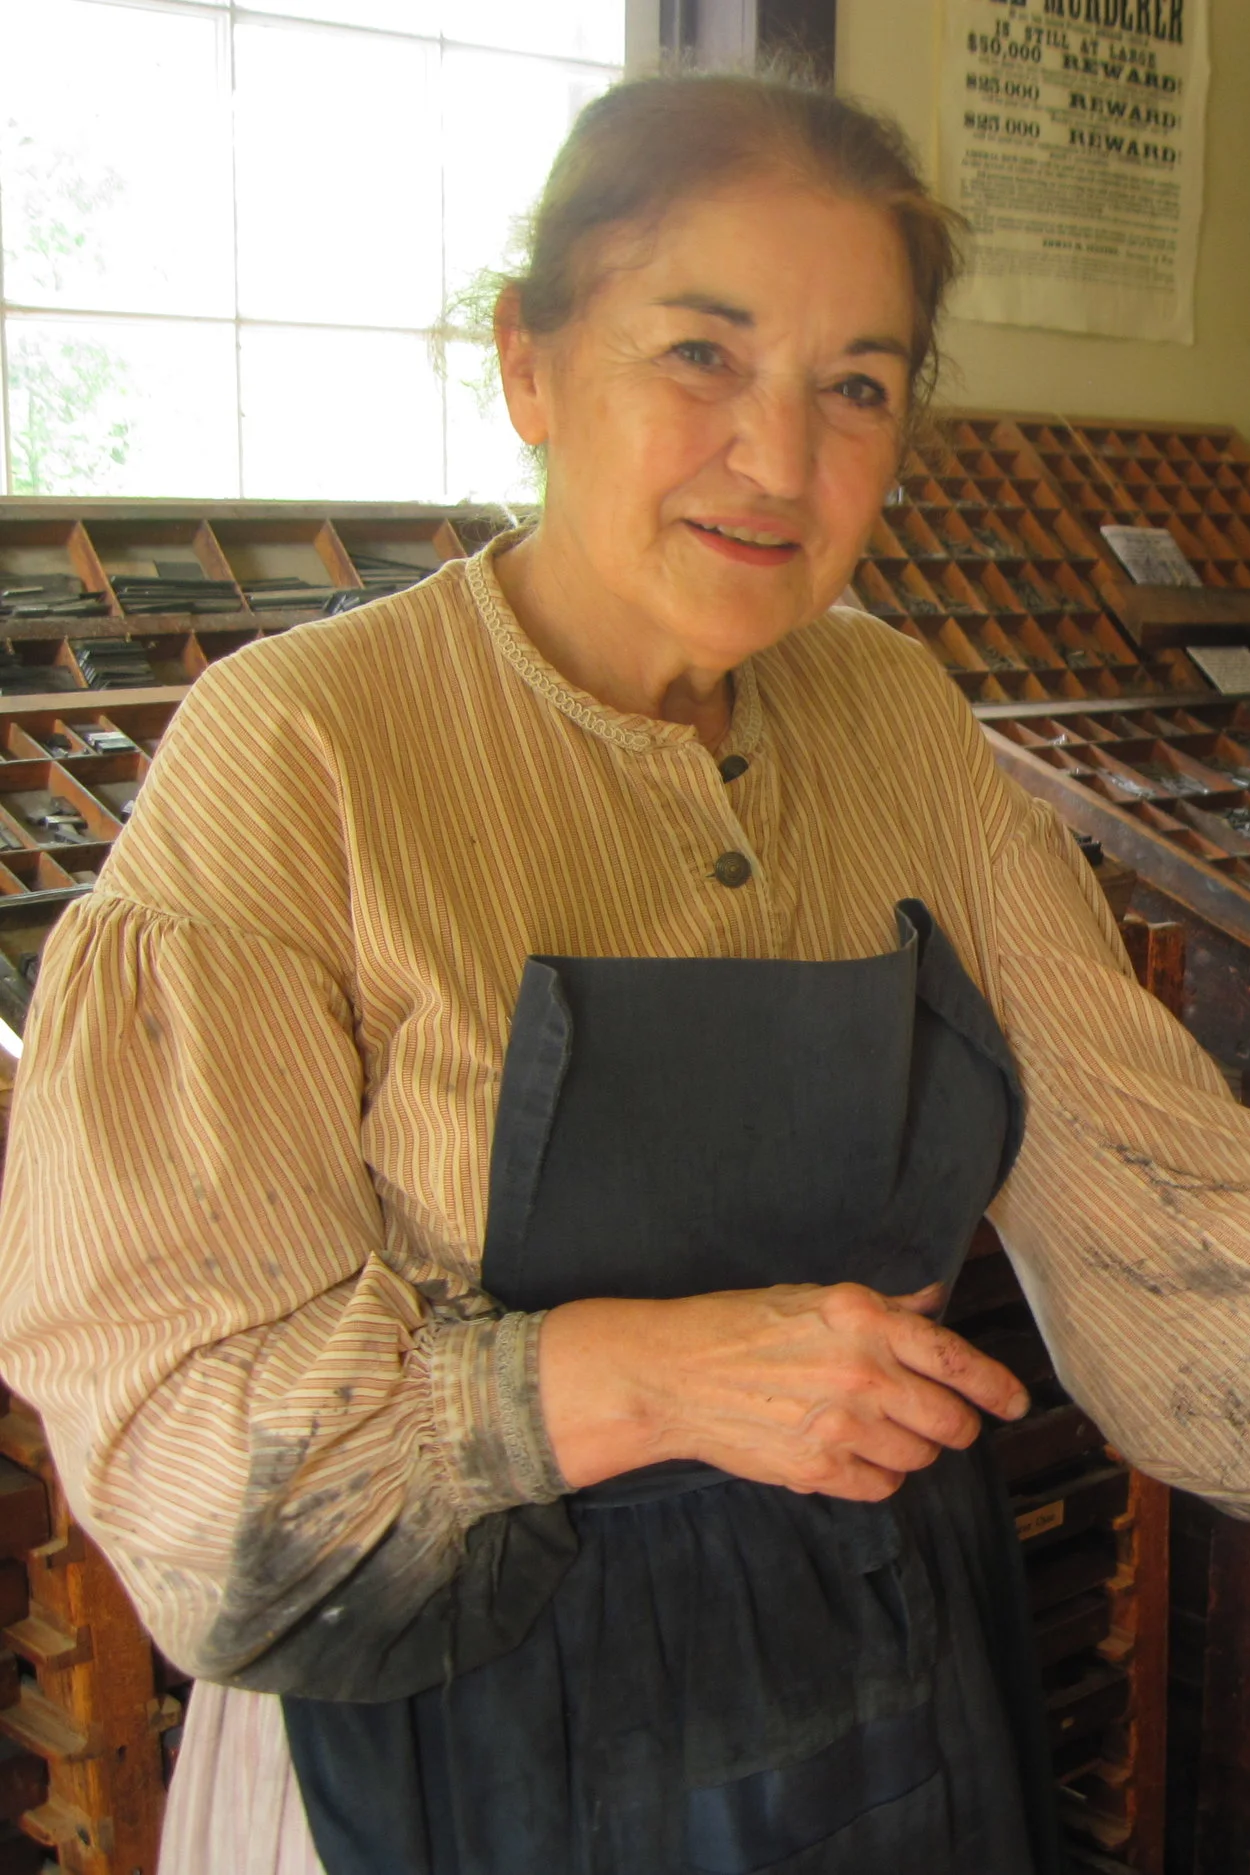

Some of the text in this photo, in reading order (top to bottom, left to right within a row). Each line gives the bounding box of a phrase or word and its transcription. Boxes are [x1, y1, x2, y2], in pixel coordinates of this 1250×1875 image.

[1043, 0, 1183, 43] DERER
[1024, 26, 1069, 50] STILL
[1080, 37, 1099, 56] AT
